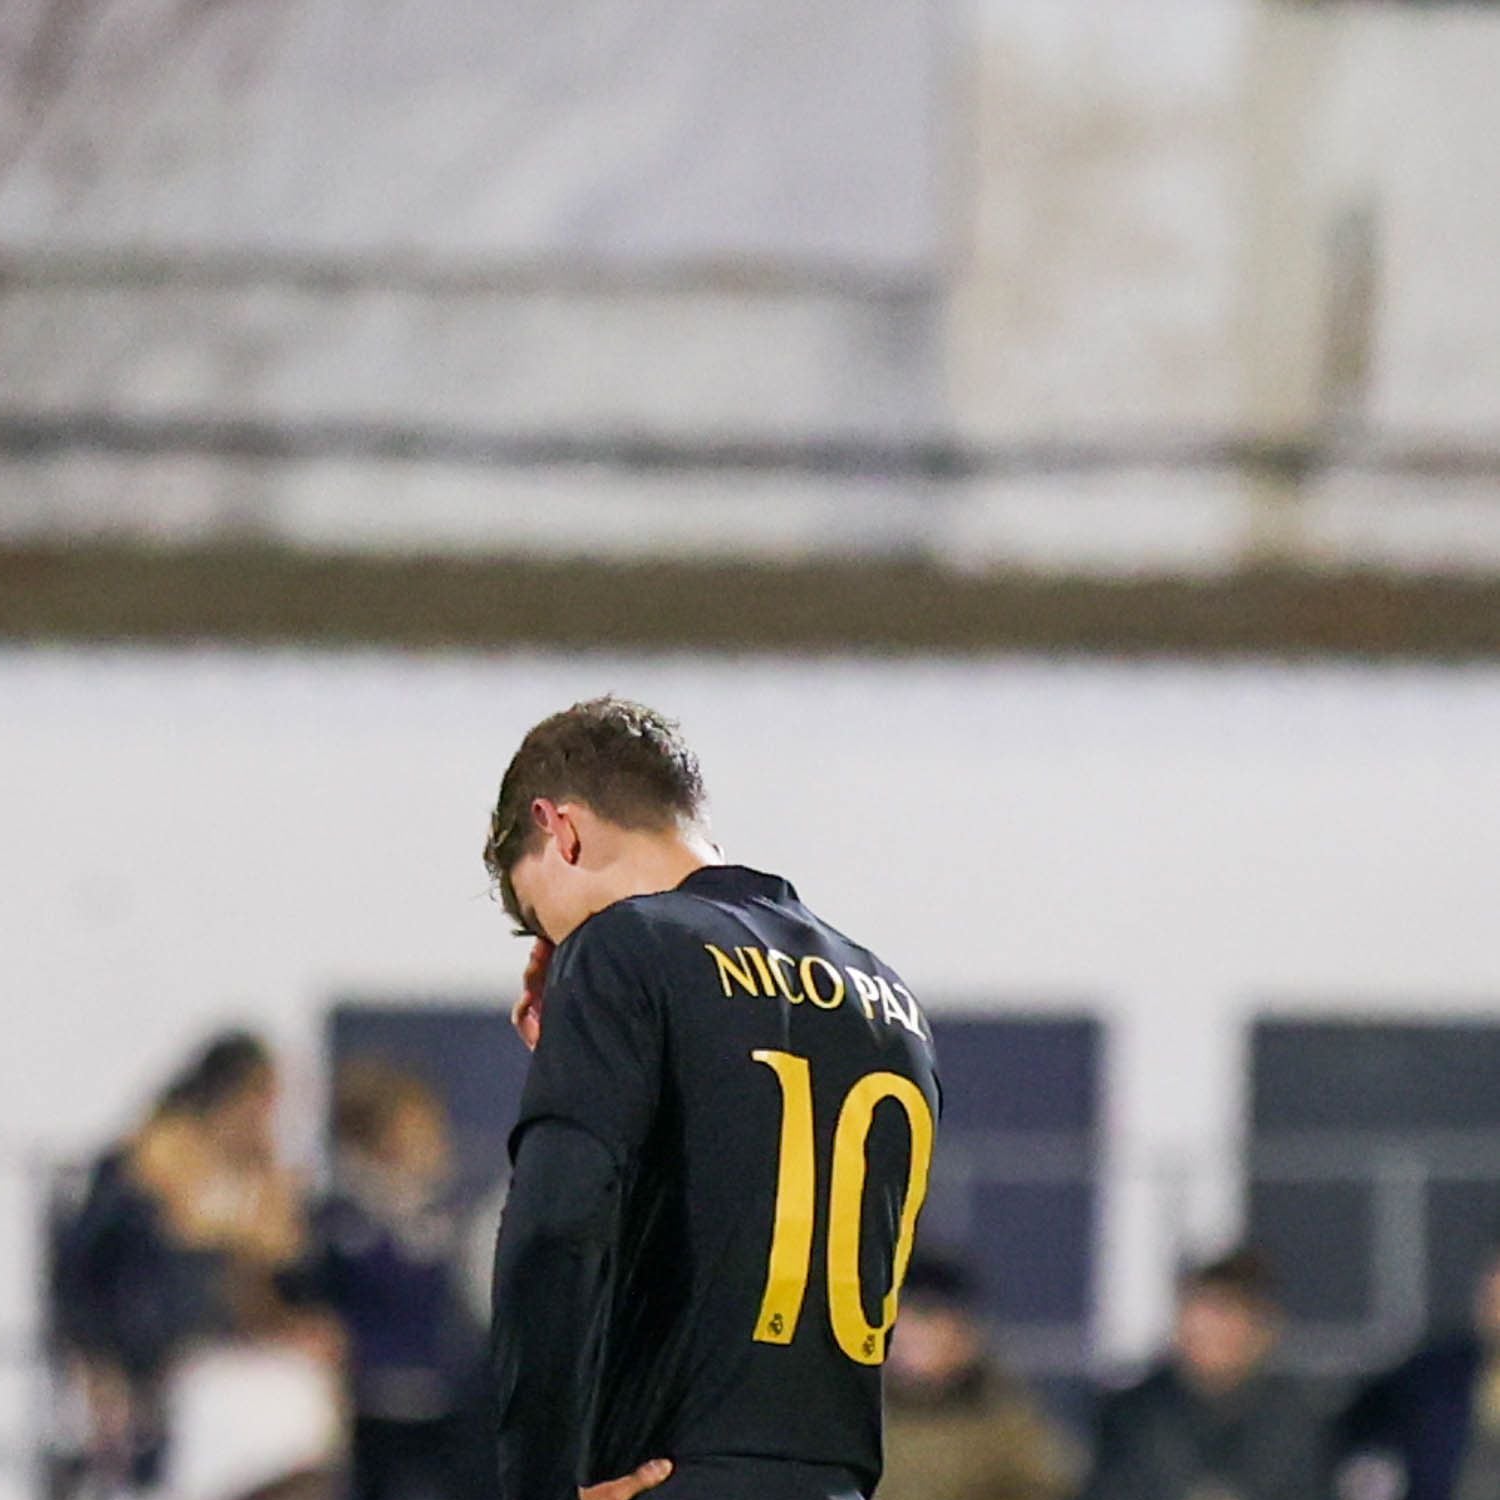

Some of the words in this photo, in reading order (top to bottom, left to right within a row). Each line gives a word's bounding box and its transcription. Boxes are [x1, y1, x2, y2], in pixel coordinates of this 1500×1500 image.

[704, 943, 845, 1009] NICO
[845, 966, 927, 1042] PAZ
[751, 1050, 934, 1366] 10
